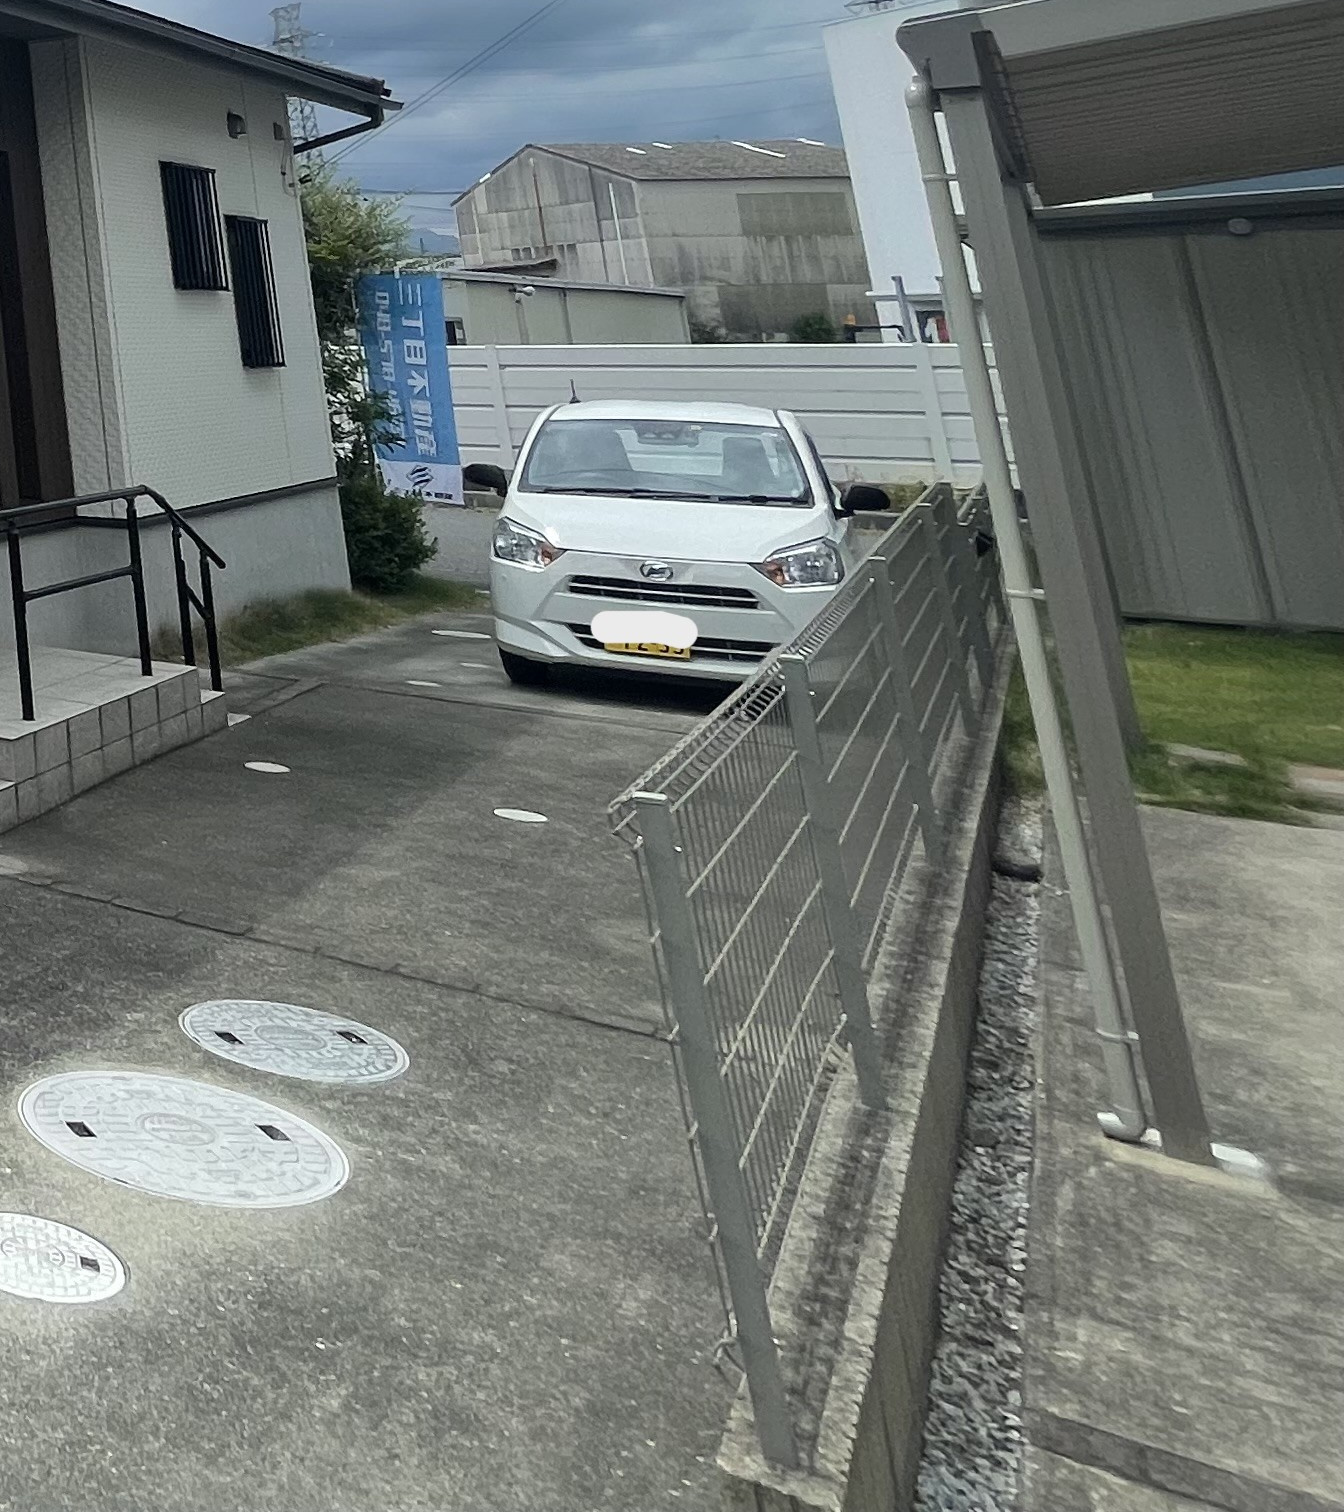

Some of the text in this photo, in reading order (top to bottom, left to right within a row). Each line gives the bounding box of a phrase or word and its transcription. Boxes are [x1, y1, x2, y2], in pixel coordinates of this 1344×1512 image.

[398, 280, 437, 457] 三丁目不動産
